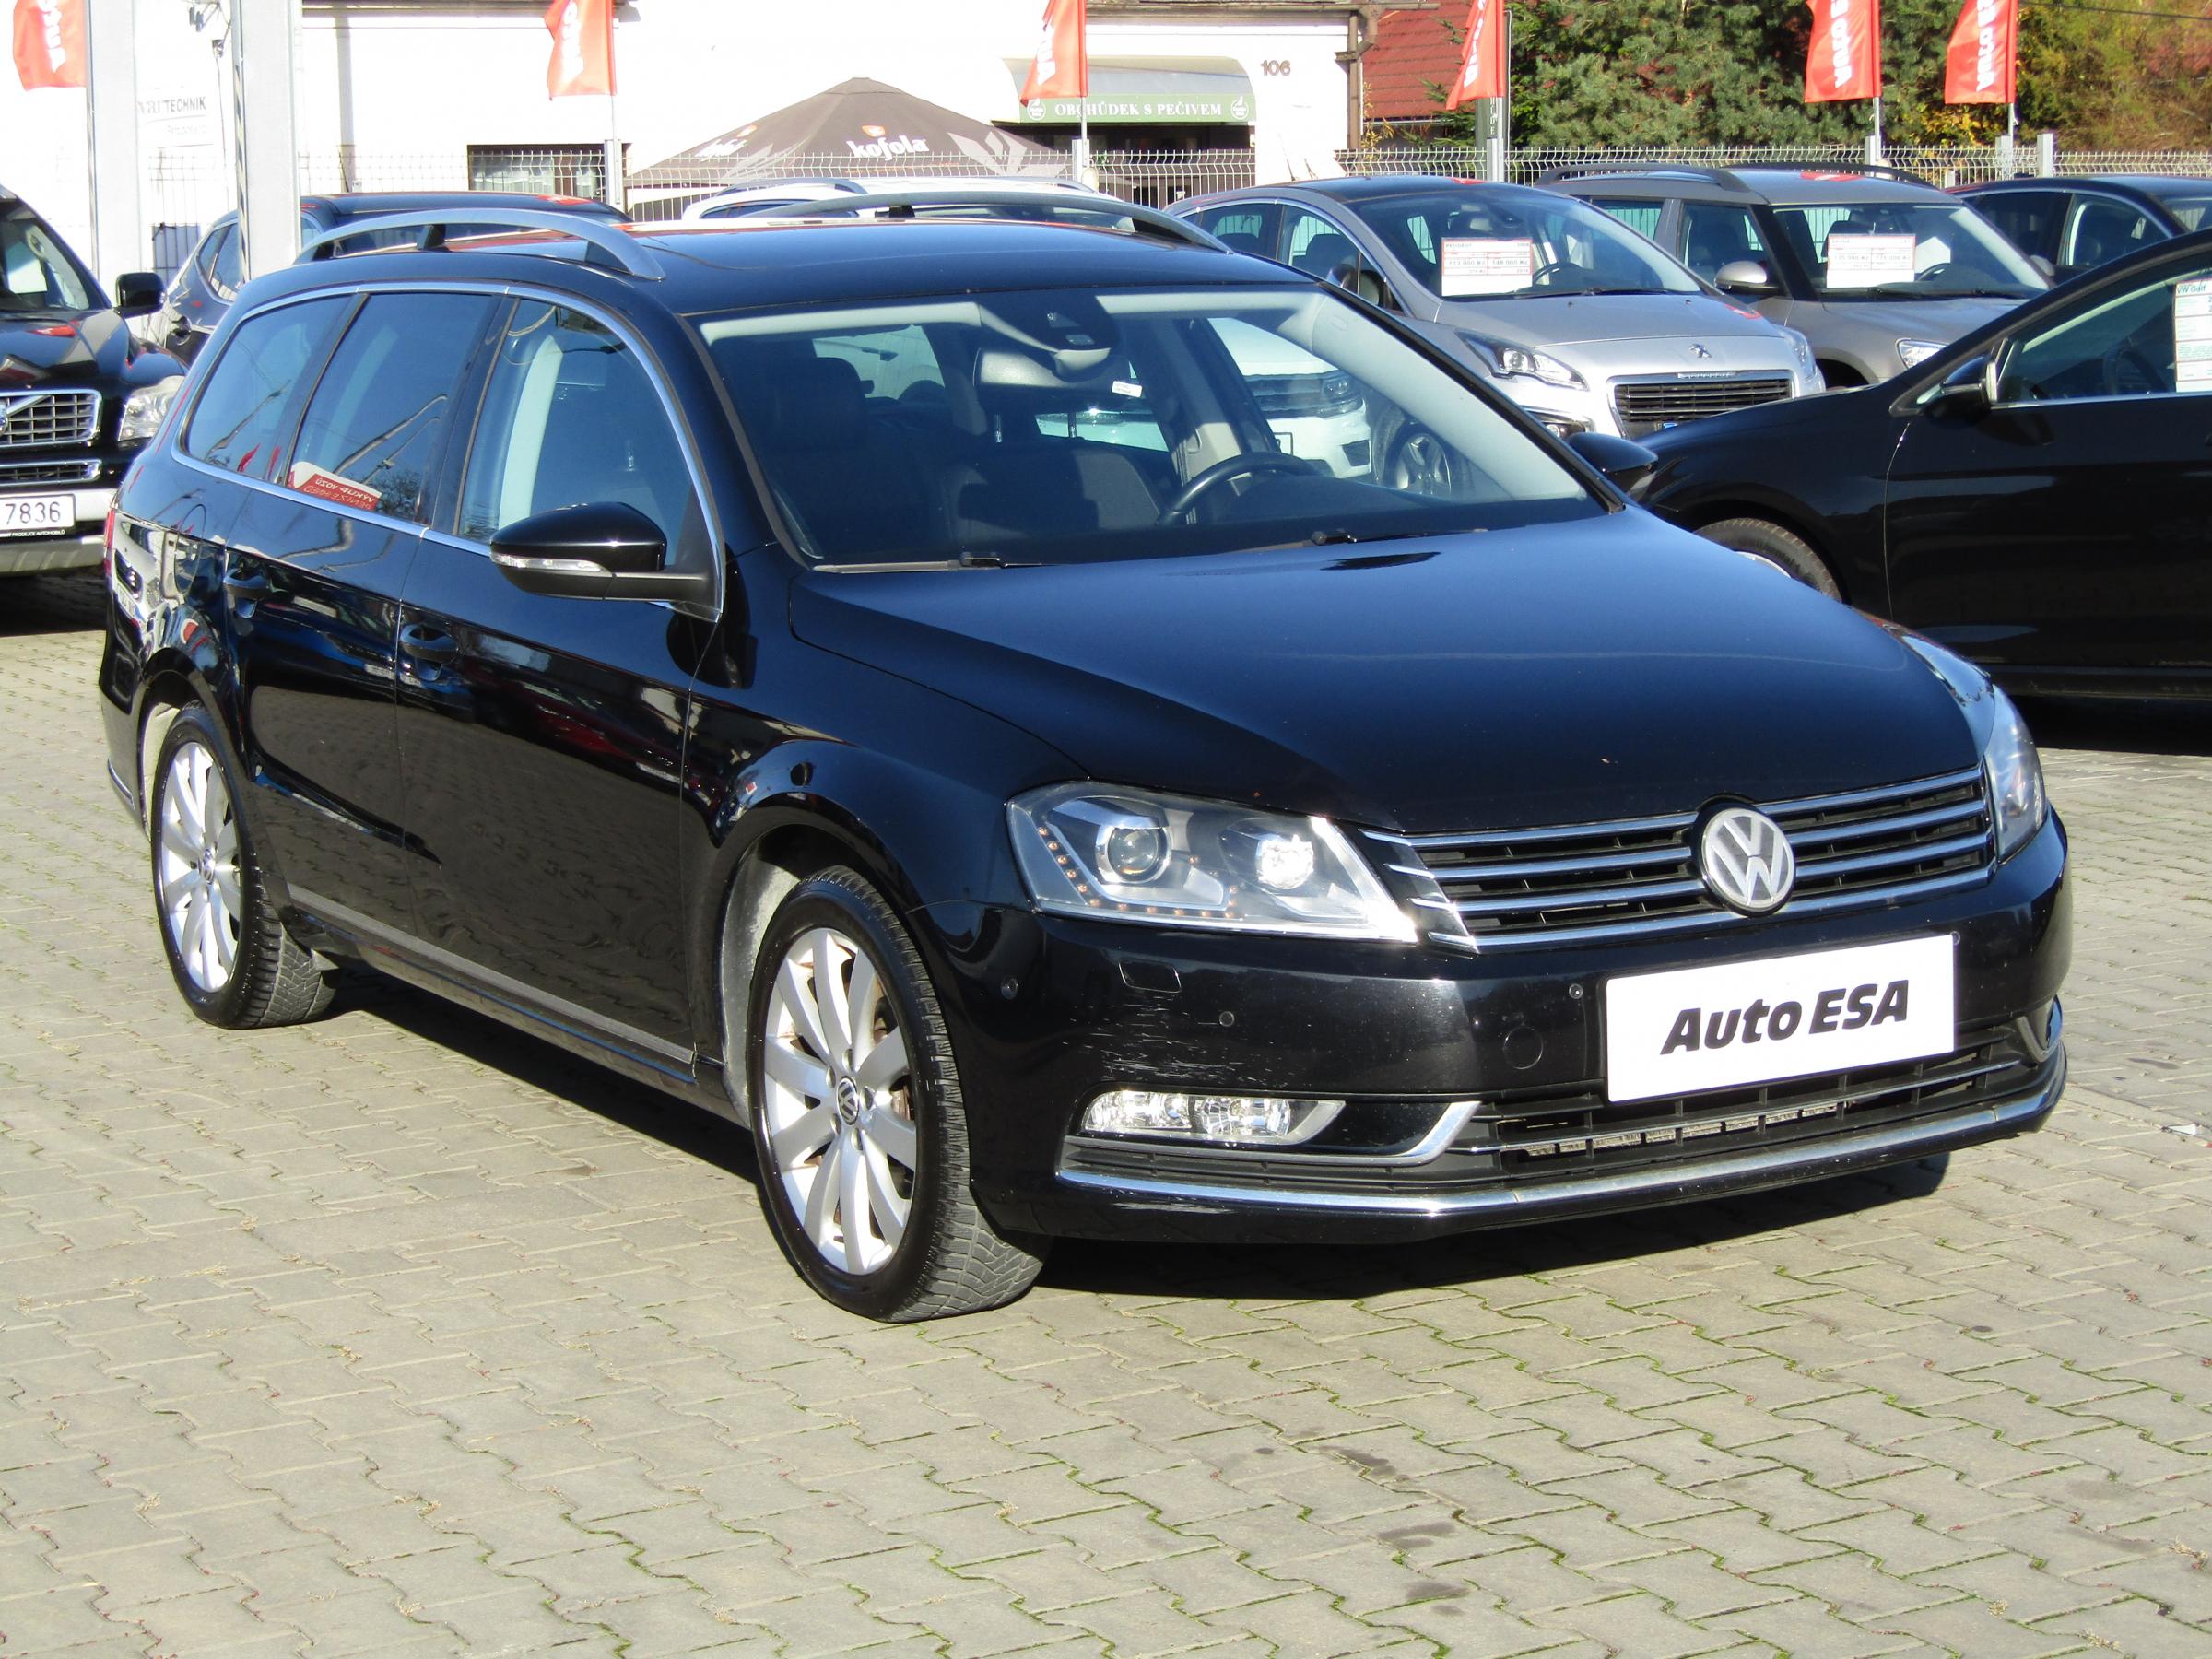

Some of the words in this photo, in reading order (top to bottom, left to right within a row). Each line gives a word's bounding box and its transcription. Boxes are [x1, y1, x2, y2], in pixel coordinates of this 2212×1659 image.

[1260, 59, 1291, 77] 106
[1143, 103, 1152, 116] S
[1157, 101, 1222, 116] PEČIVEM
[846, 135, 929, 161] kofola
[5, 501, 61, 525] 7836
[1659, 999, 1802, 1055] Auto
[1808, 980, 1909, 1035] ESA
